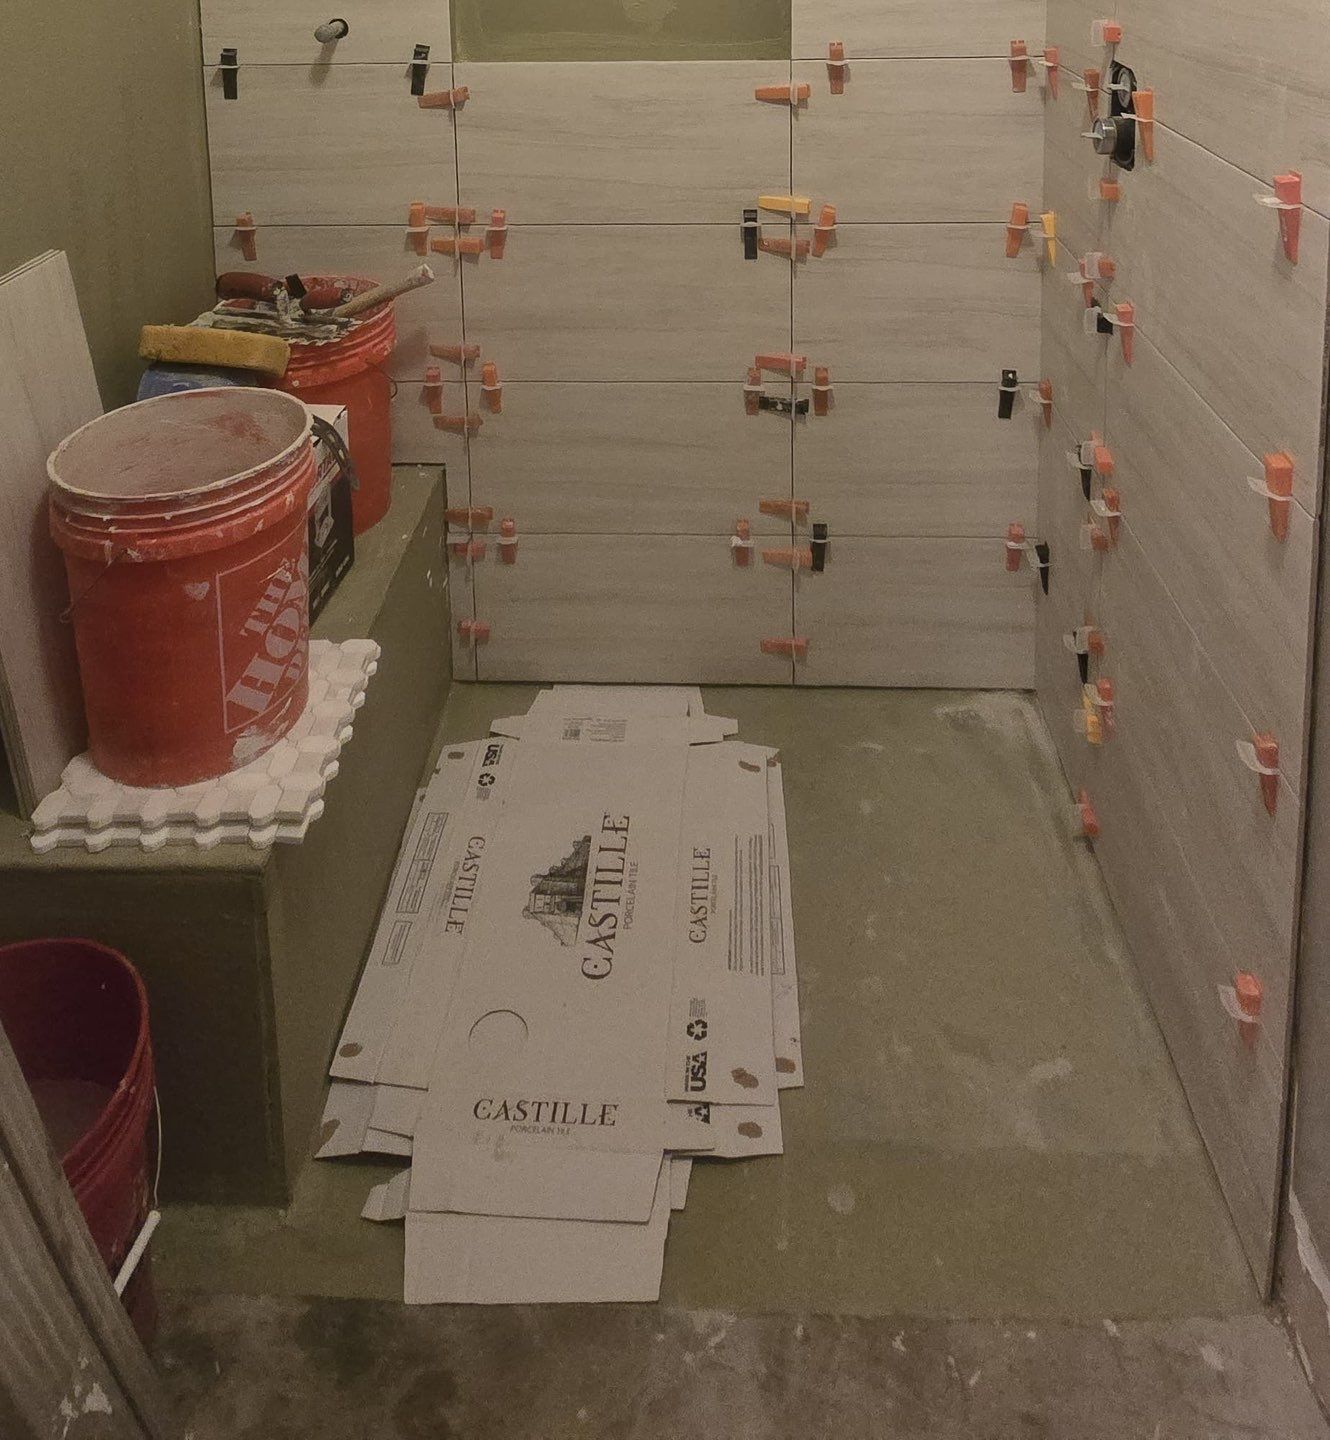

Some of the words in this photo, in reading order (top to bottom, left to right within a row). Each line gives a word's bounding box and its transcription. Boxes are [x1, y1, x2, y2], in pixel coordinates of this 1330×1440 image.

[445, 836, 485, 935] CASTILLE
[629, 861, 638, 877] TILE
[581, 812, 630, 980] CASTILLE
[623, 880, 637, 929] PORCELAIN
[689, 847, 711, 943] CASTILLE
[691, 1051, 708, 1092] USA
[474, 1098, 620, 1127] CASTILLE
